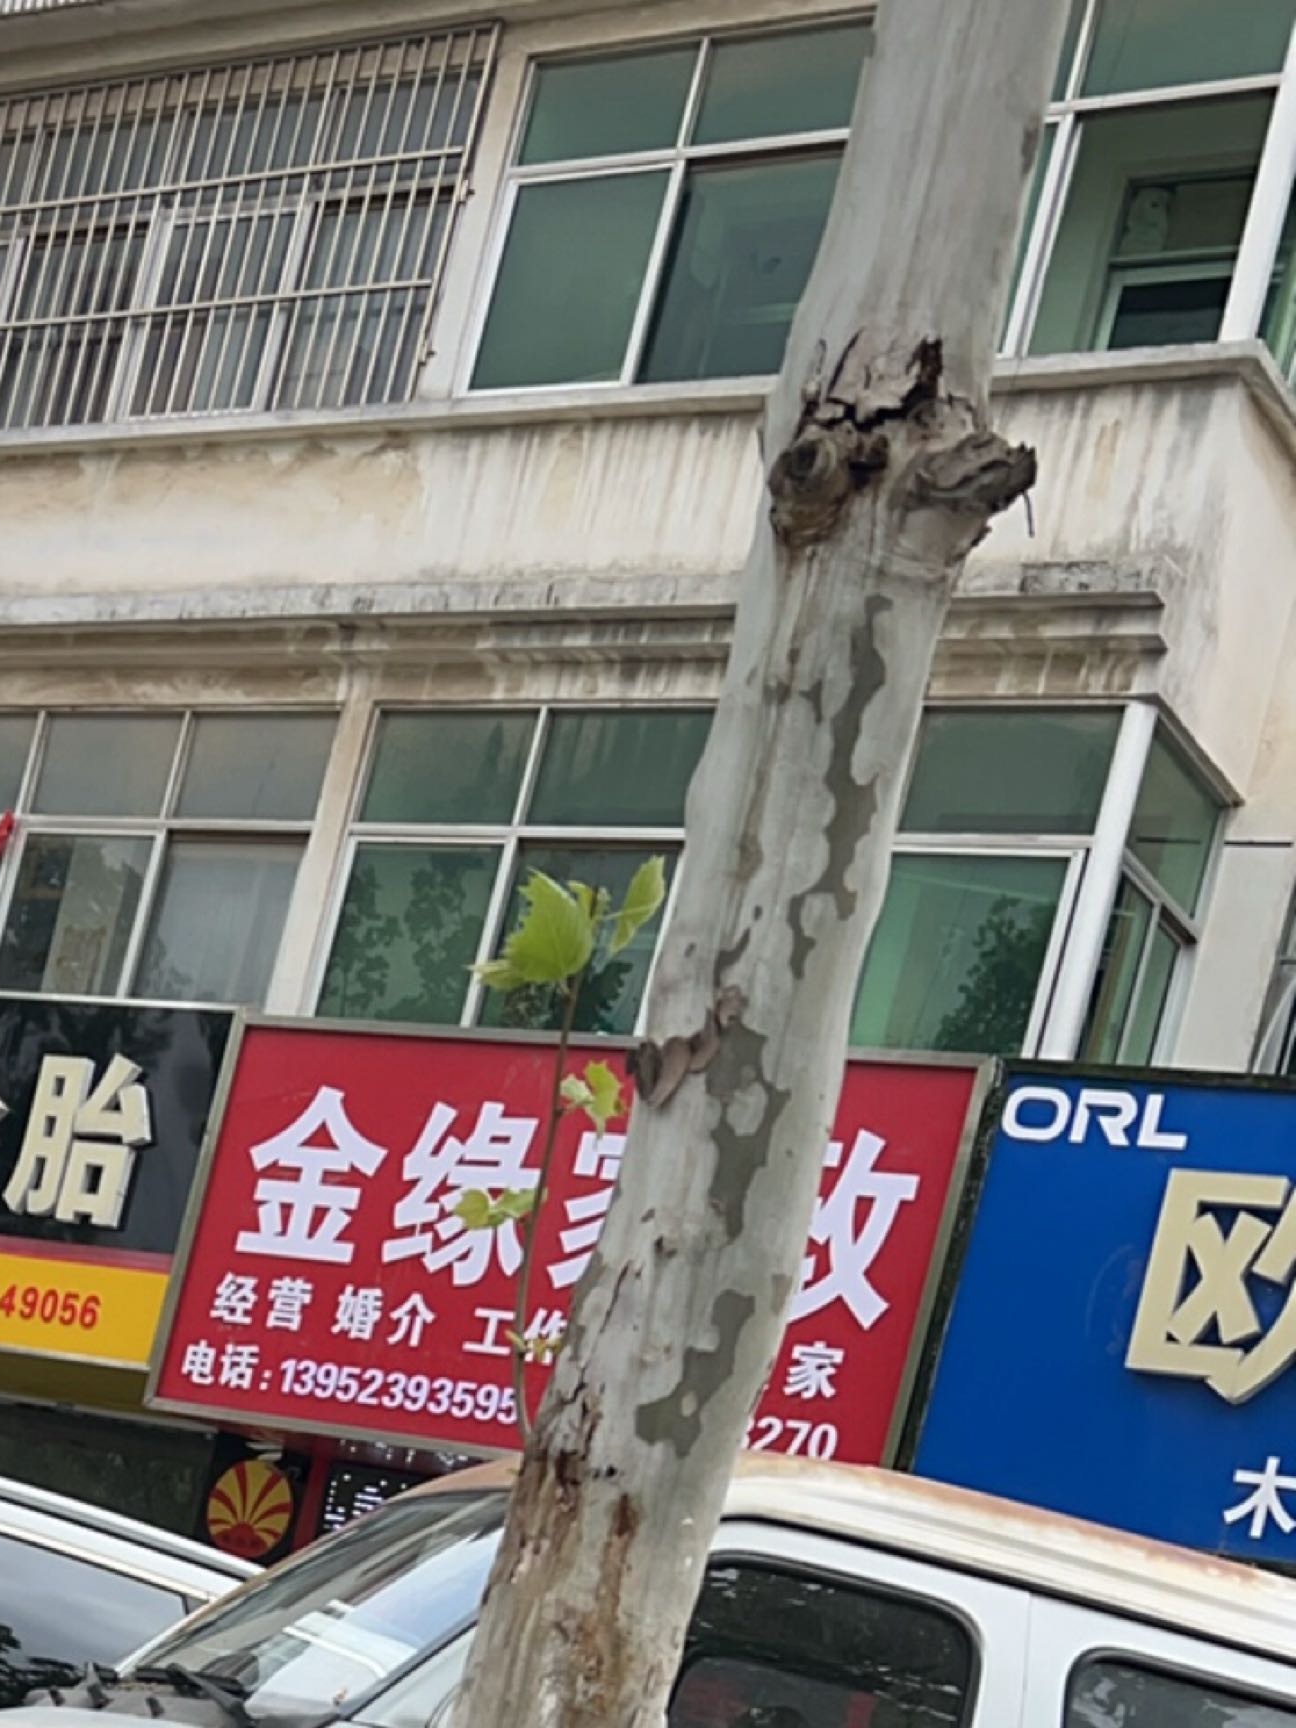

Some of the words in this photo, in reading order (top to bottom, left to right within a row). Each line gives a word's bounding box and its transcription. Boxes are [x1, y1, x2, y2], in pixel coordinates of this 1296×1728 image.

[1001, 1085, 1188, 1150] ORL
[209, 1271, 313, 1333] 经营
[331, 1284, 436, 1348] 婚介
[742, 1415, 839, 1461] 270
[1223, 1455, 1296, 1540] 木
